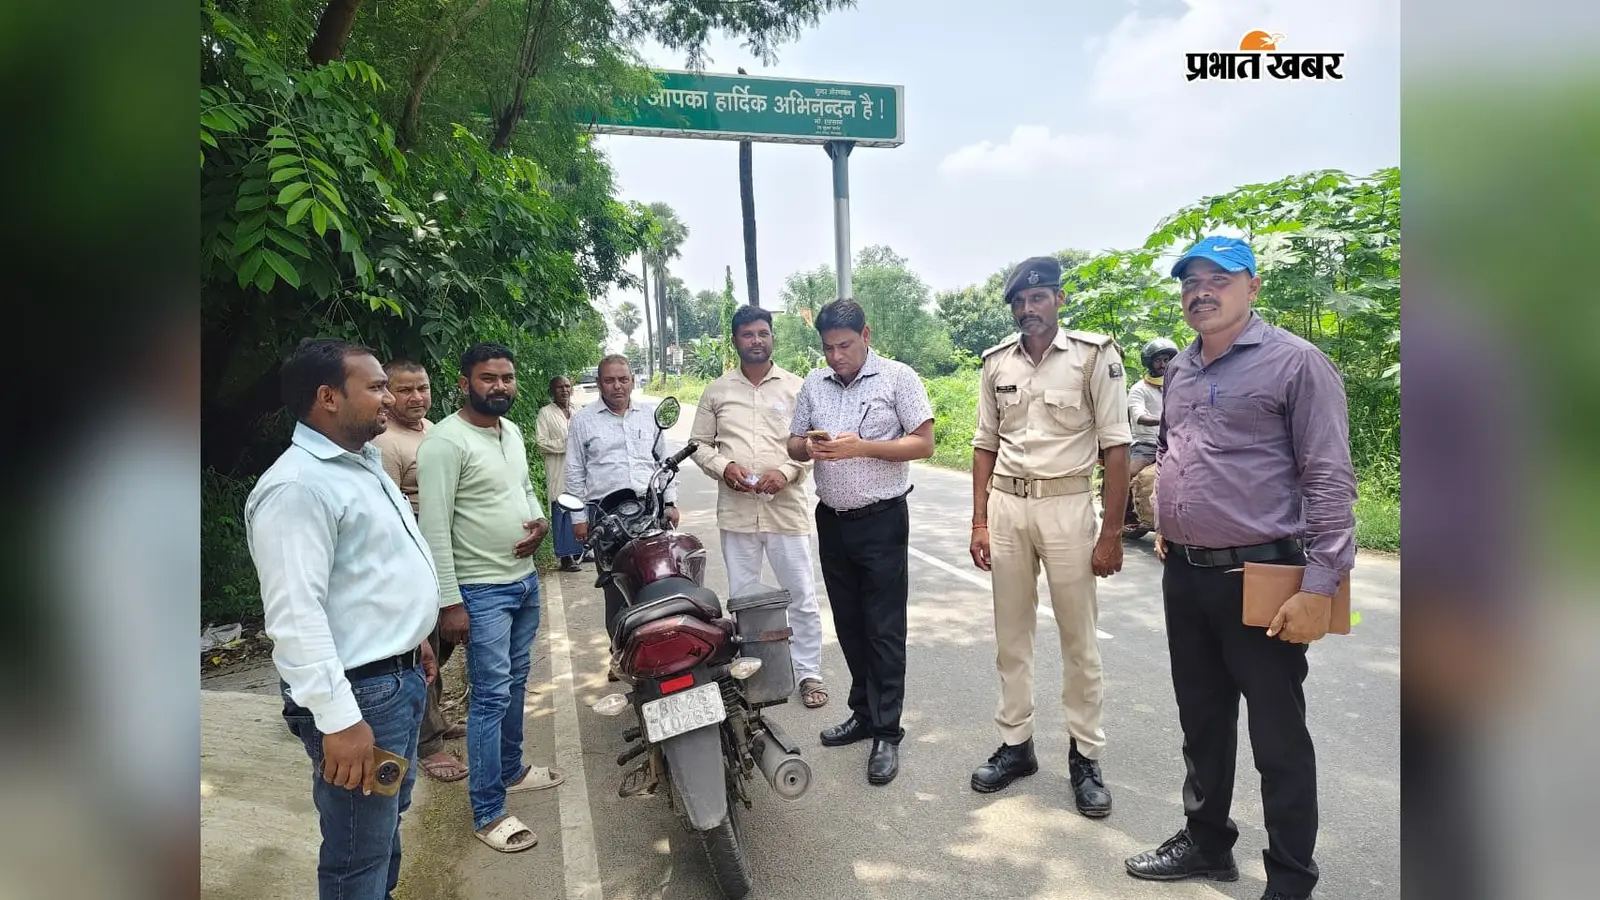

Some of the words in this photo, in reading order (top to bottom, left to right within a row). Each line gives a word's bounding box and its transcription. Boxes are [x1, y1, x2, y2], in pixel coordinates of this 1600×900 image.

[647, 88, 708, 110] आपका
[714, 85, 768, 113] हार्दिक
[774, 90, 857, 118] अभिनन्दन
[659, 697, 681, 718] BR
